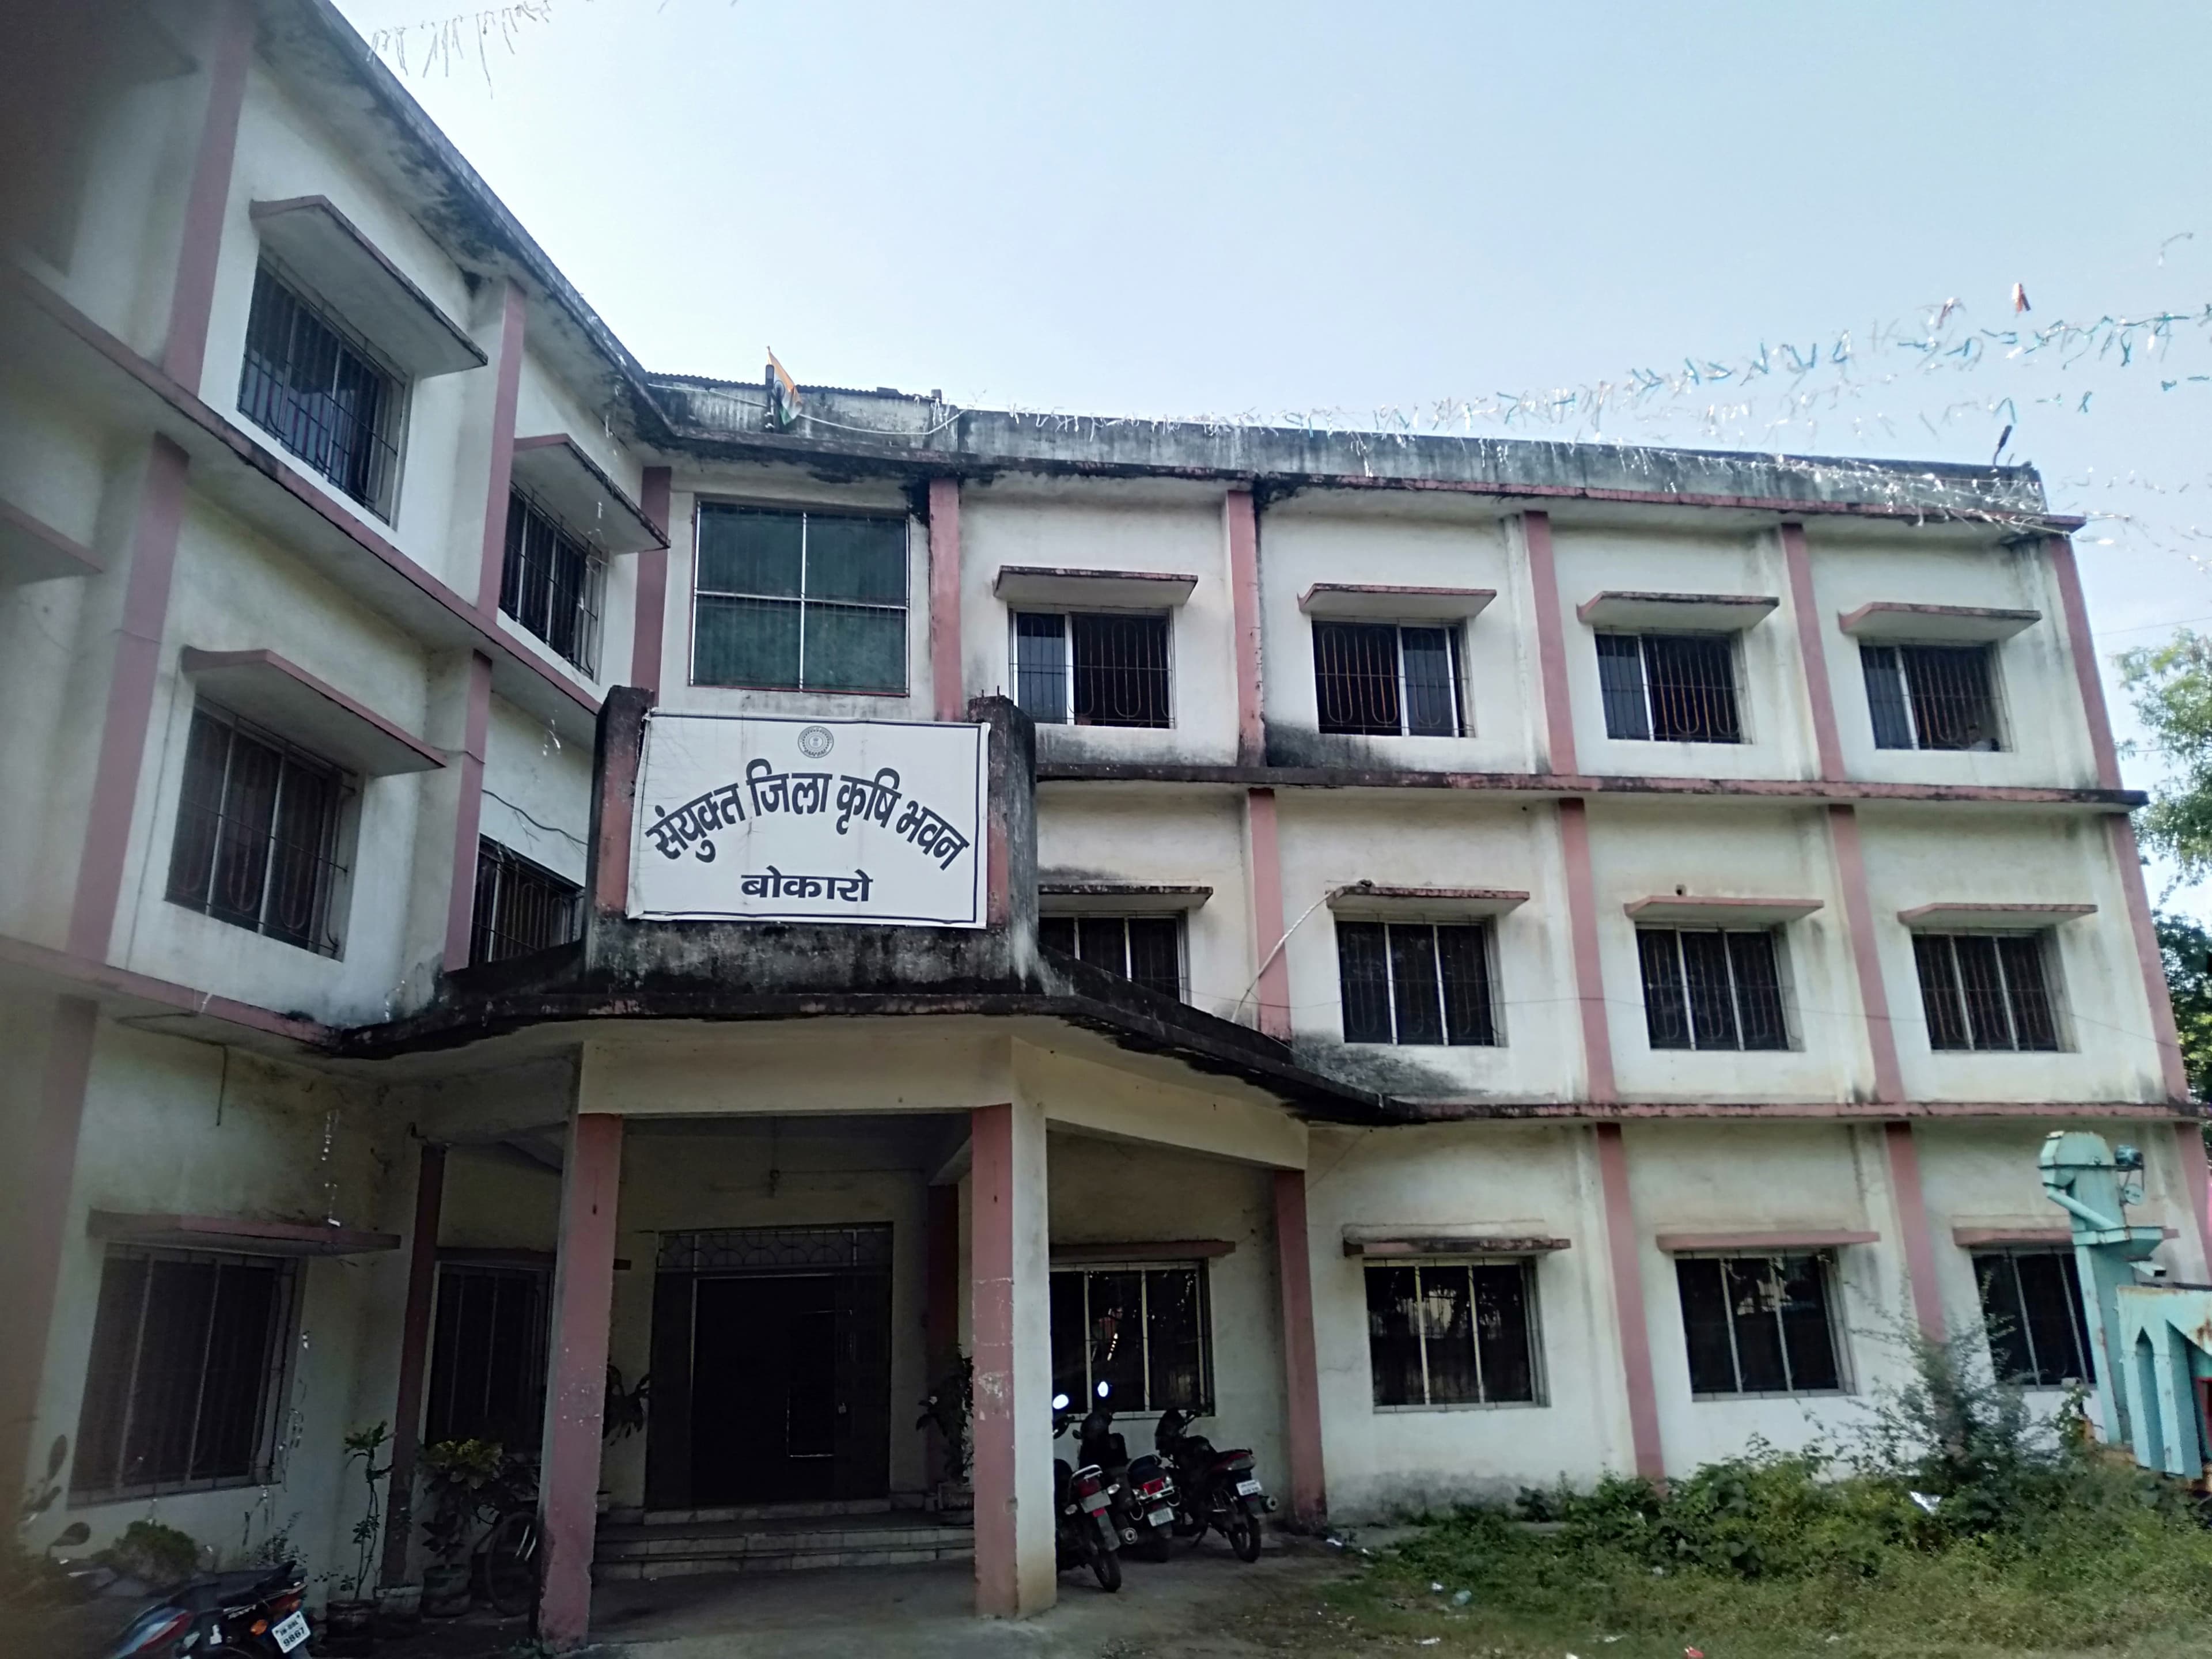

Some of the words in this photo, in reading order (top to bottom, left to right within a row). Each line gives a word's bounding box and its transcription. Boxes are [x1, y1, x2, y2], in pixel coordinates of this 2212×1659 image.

[645, 782, 746, 863] संयुक्त
[745, 758, 833, 817] जिला
[836, 767, 903, 835] कृषि
[896, 800, 970, 871] भवन
[741, 865, 874, 902] बोकारो
[283, 1627, 305, 1646] 9867
